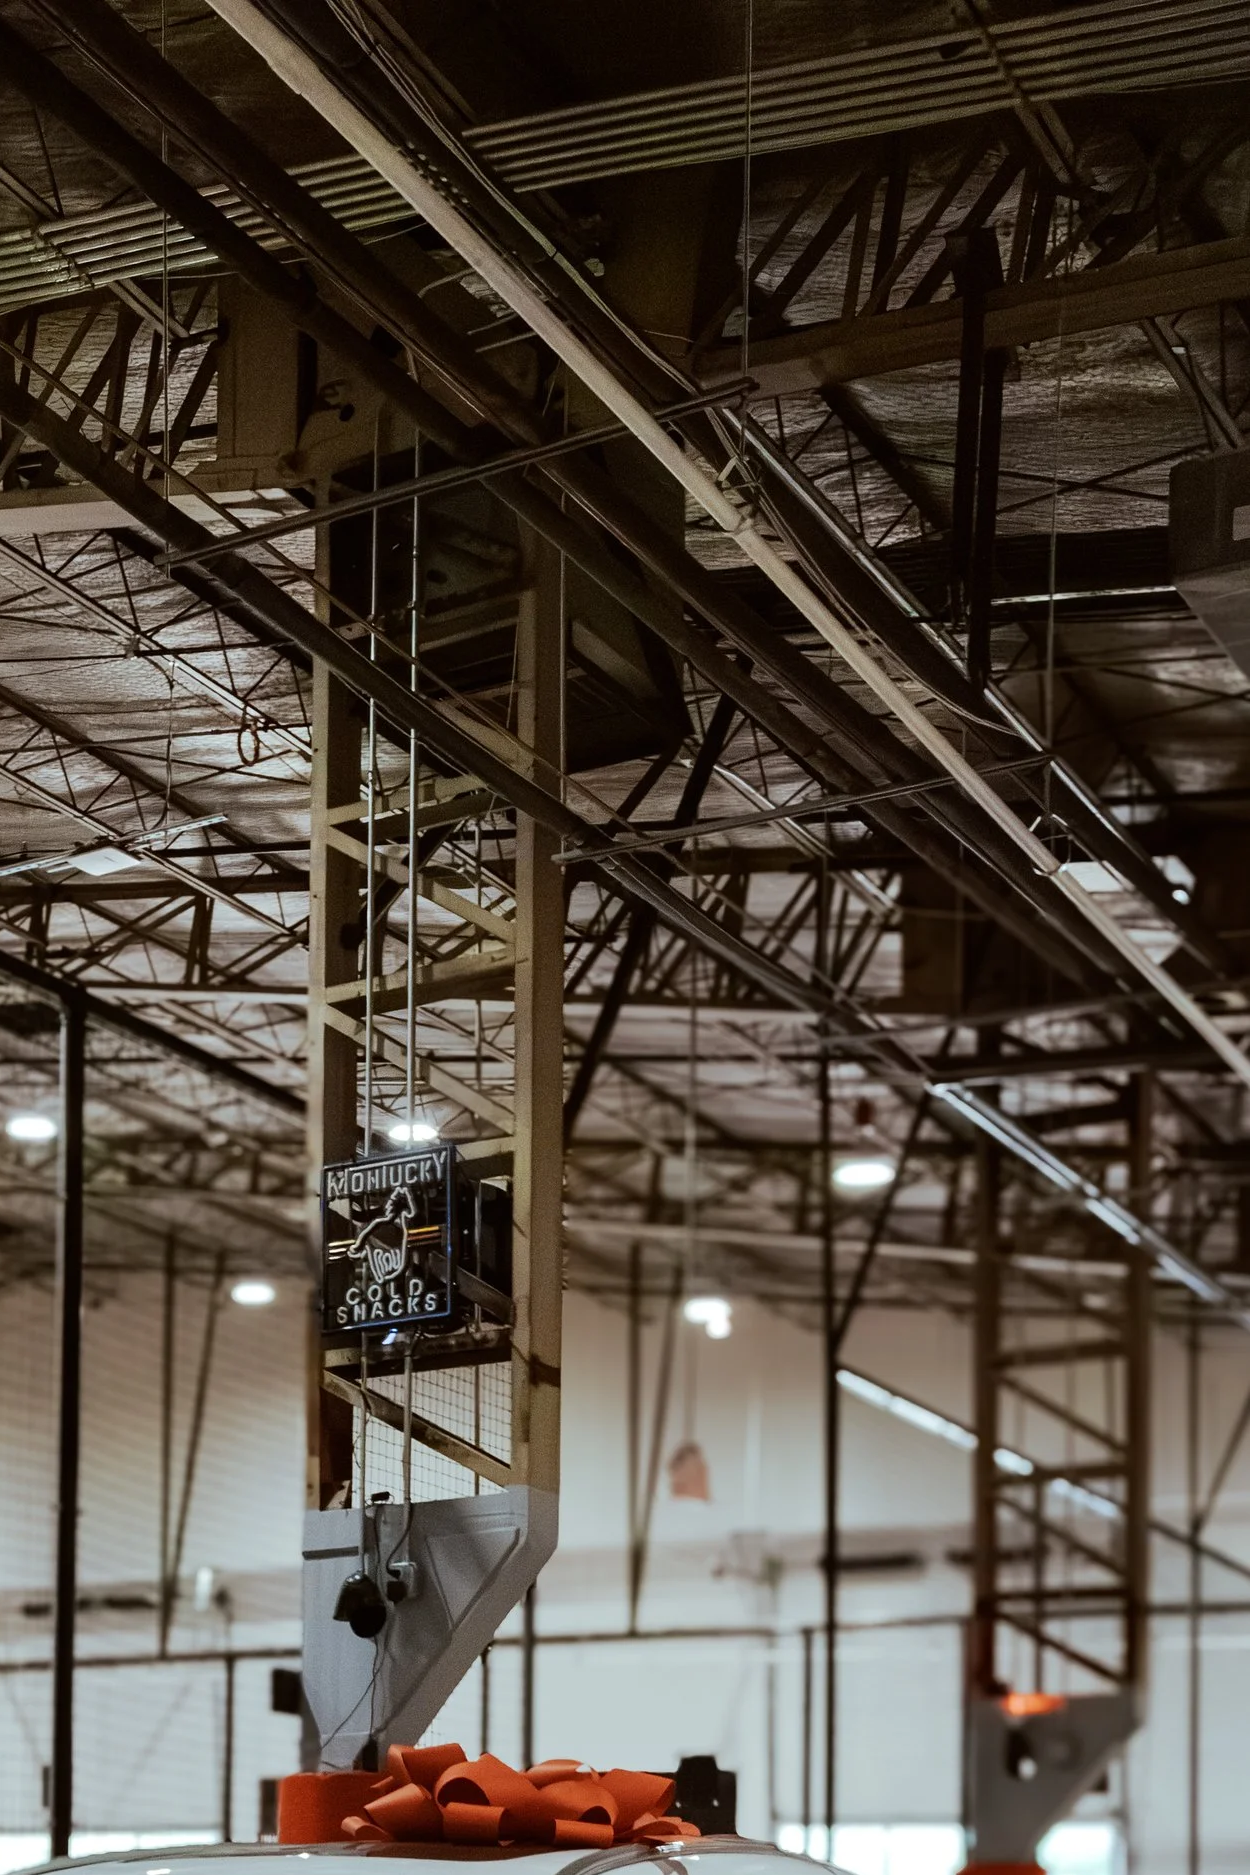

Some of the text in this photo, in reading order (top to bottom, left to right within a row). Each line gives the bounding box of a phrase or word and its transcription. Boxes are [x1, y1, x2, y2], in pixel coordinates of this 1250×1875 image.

[327, 1151, 446, 1197] MONTUCKY
[346, 1279, 423, 1305] COLD
[337, 1294, 437, 1323] SNACKS
